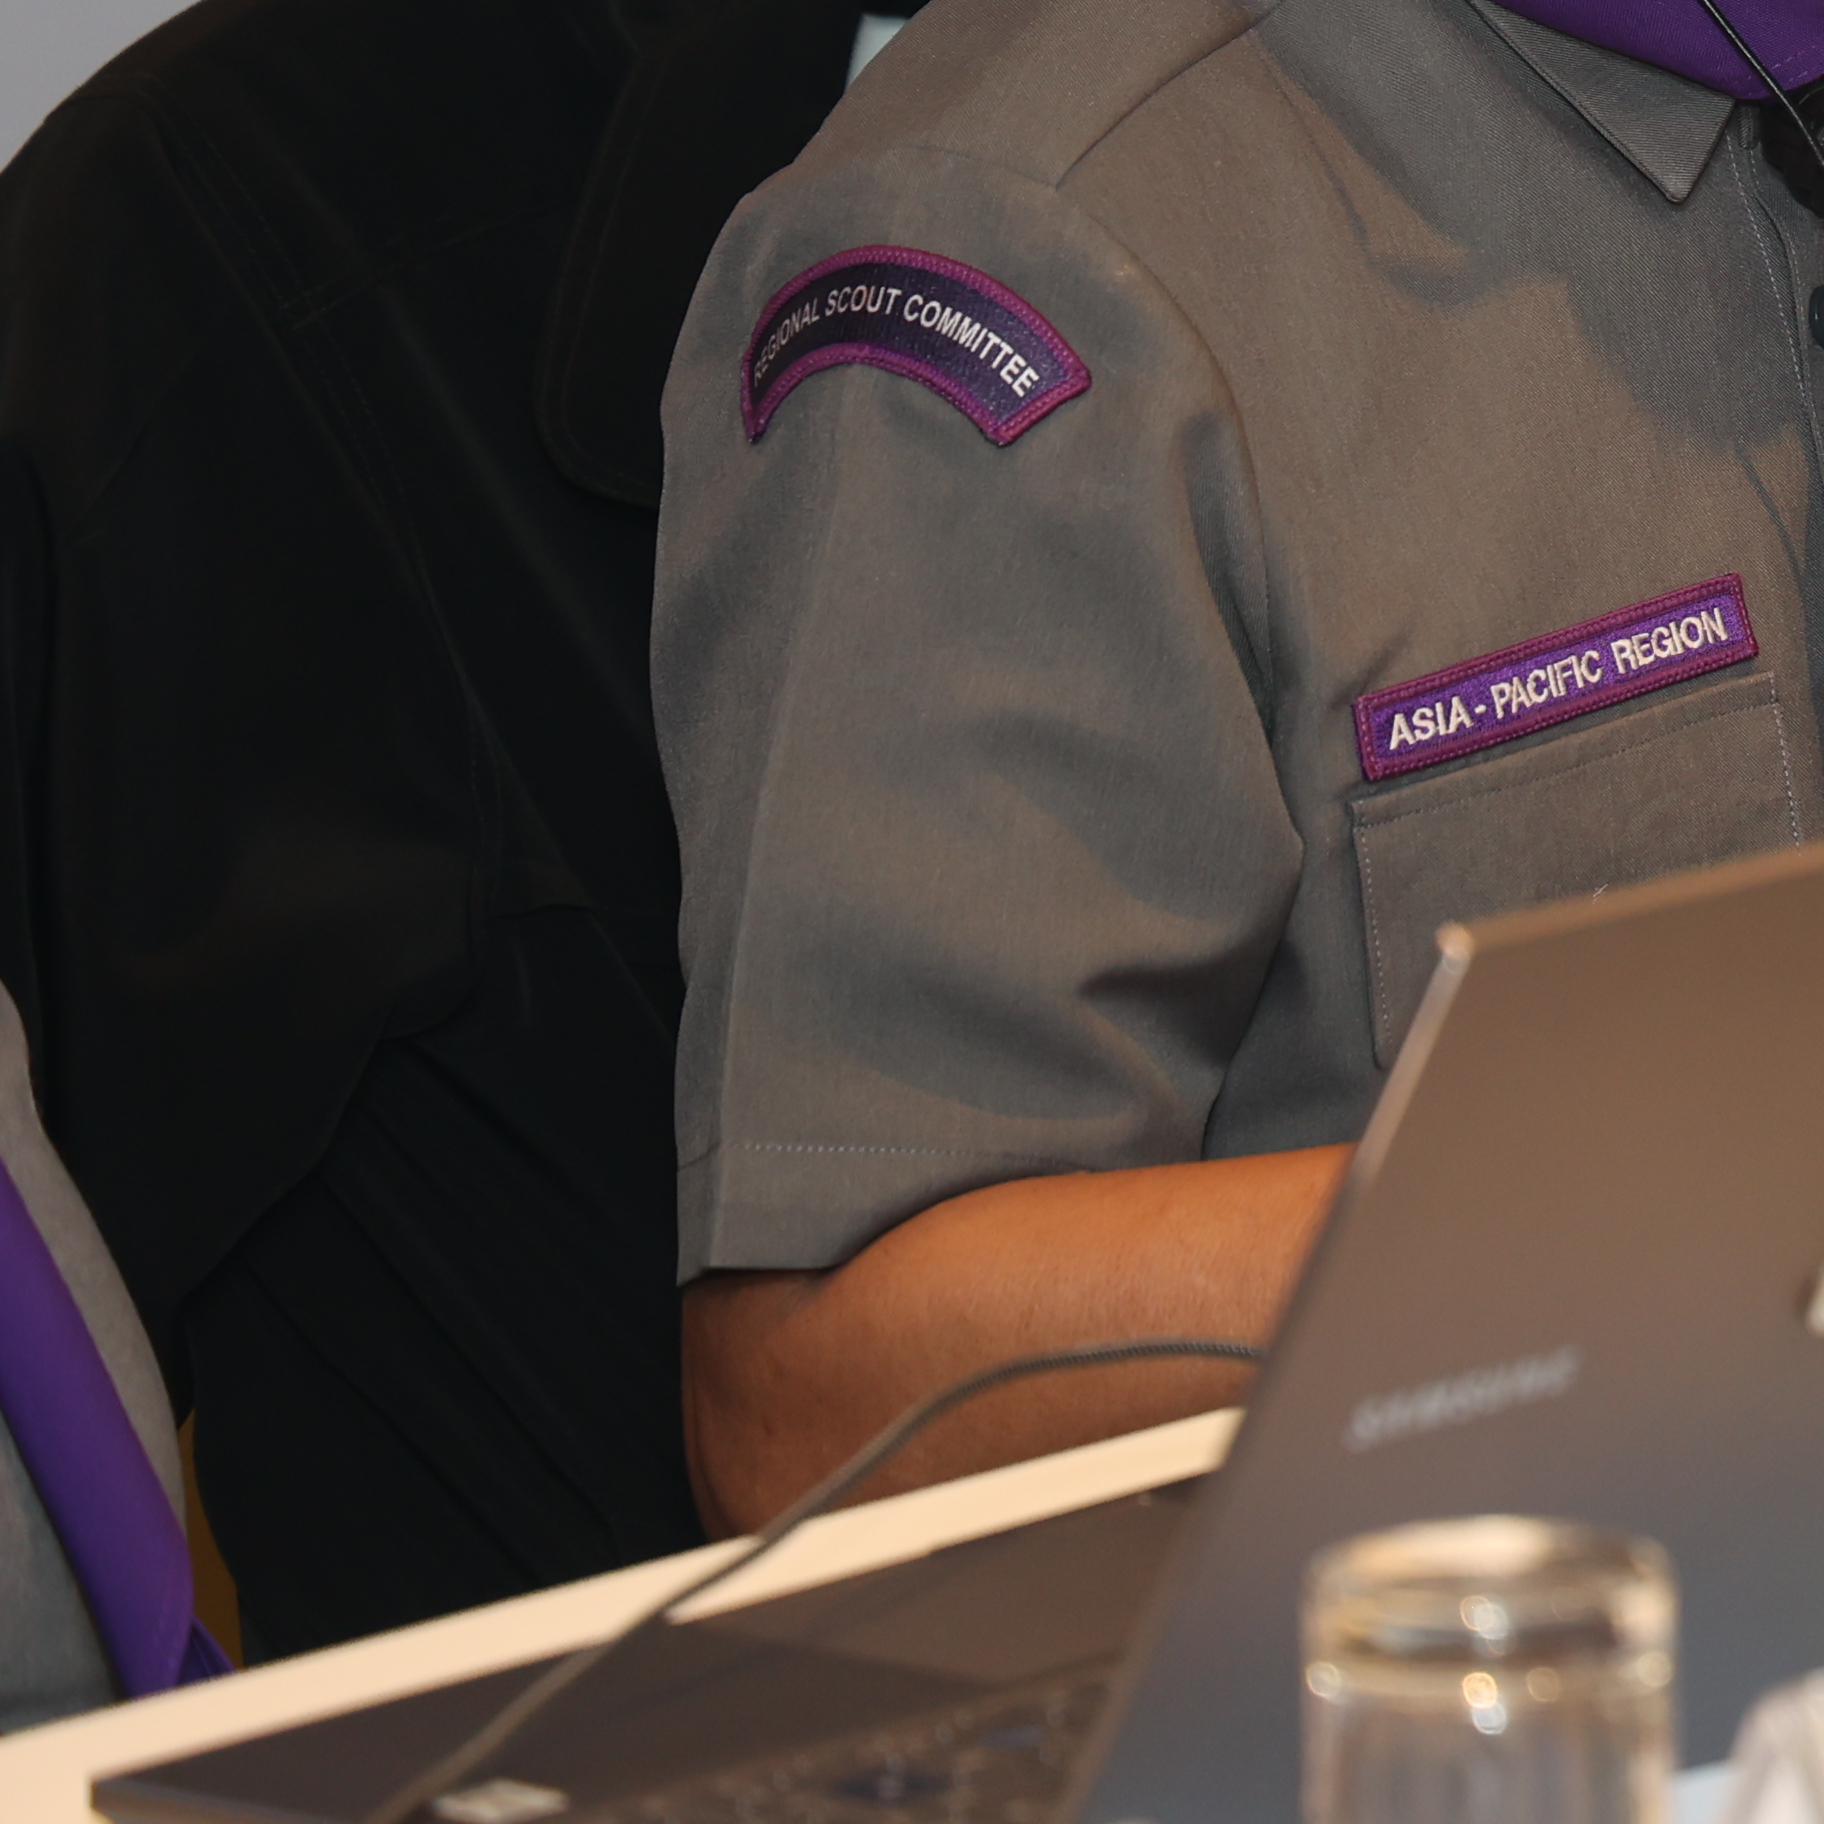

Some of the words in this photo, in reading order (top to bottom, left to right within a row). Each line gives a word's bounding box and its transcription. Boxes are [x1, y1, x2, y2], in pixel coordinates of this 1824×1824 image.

[754, 298, 820, 387] REGIONAL
[824, 284, 902, 318] SCOUT
[903, 293, 1040, 398] COMMITTEE
[1388, 693, 1475, 751] ASIA
[1489, 650, 1602, 720] PACIFIC
[1610, 606, 1729, 675] REGION
